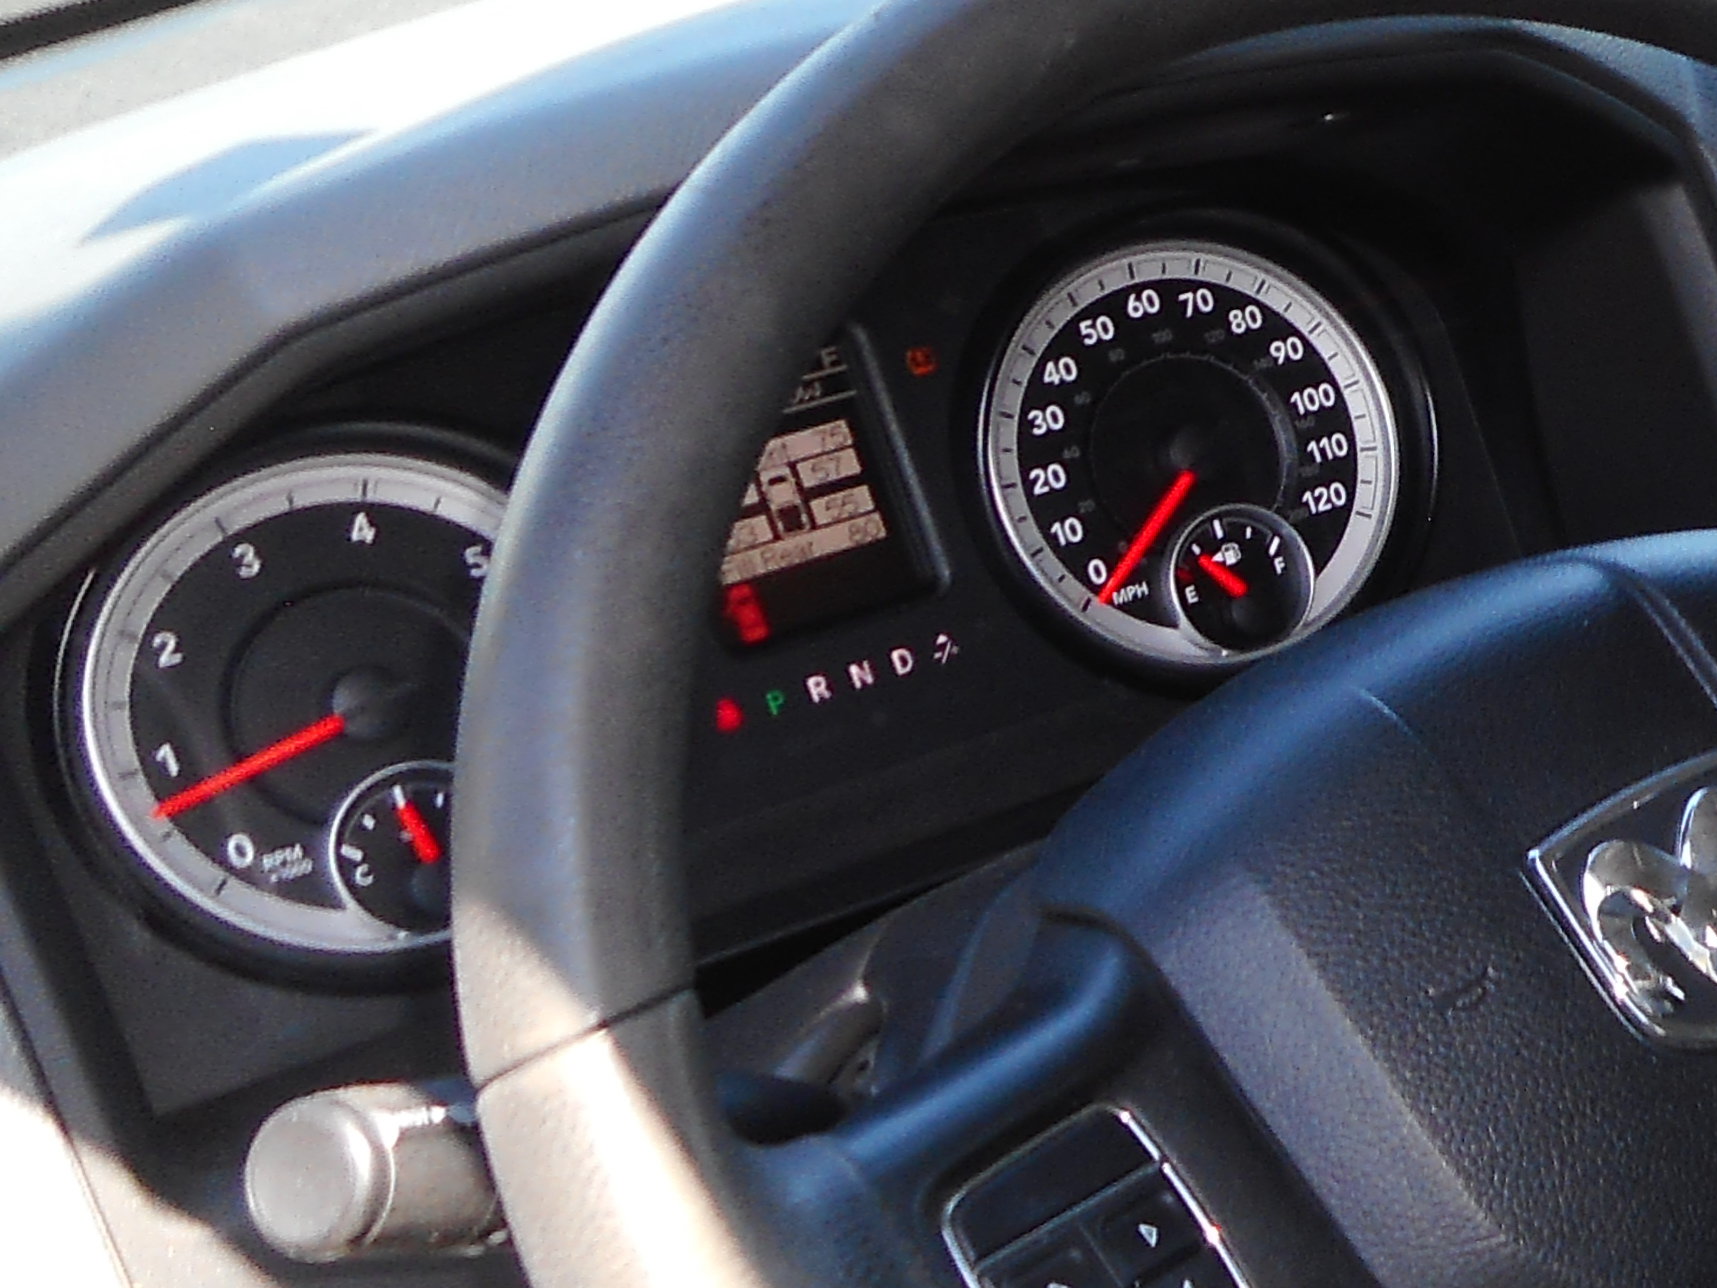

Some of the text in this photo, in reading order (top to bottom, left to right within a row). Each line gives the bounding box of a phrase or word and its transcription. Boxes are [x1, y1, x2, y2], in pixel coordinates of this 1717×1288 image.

[1126, 289, 1161, 318] 60
[1178, 288, 1215, 318] 70
[1078, 315, 1115, 346] 50
[1228, 305, 1263, 335] 80
[1270, 336, 1304, 366] 90
[1042, 357, 1079, 387] 40
[1290, 382, 1336, 416] 100
[1027, 404, 1065, 436] 30
[1306, 432, 1349, 465] 110
[809, 456, 842, 481] 57
[1028, 463, 1067, 496] 20
[1301, 481, 1347, 516] 120
[349, 513, 377, 545] 4
[1050, 516, 1084, 547] 10
[232, 543, 263, 579] 3
[464, 546, 489, 578] 5
[1087, 558, 1108, 586] 0
[1275, 557, 1287, 575] F
[1112, 582, 1150, 605] MPH
[1185, 585, 1199, 605] E
[153, 631, 184, 669] 2
[765, 647, 914, 716] P R N D
[156, 743, 181, 778] 1
[227, 833, 255, 868] 0
[355, 865, 374, 888] C
